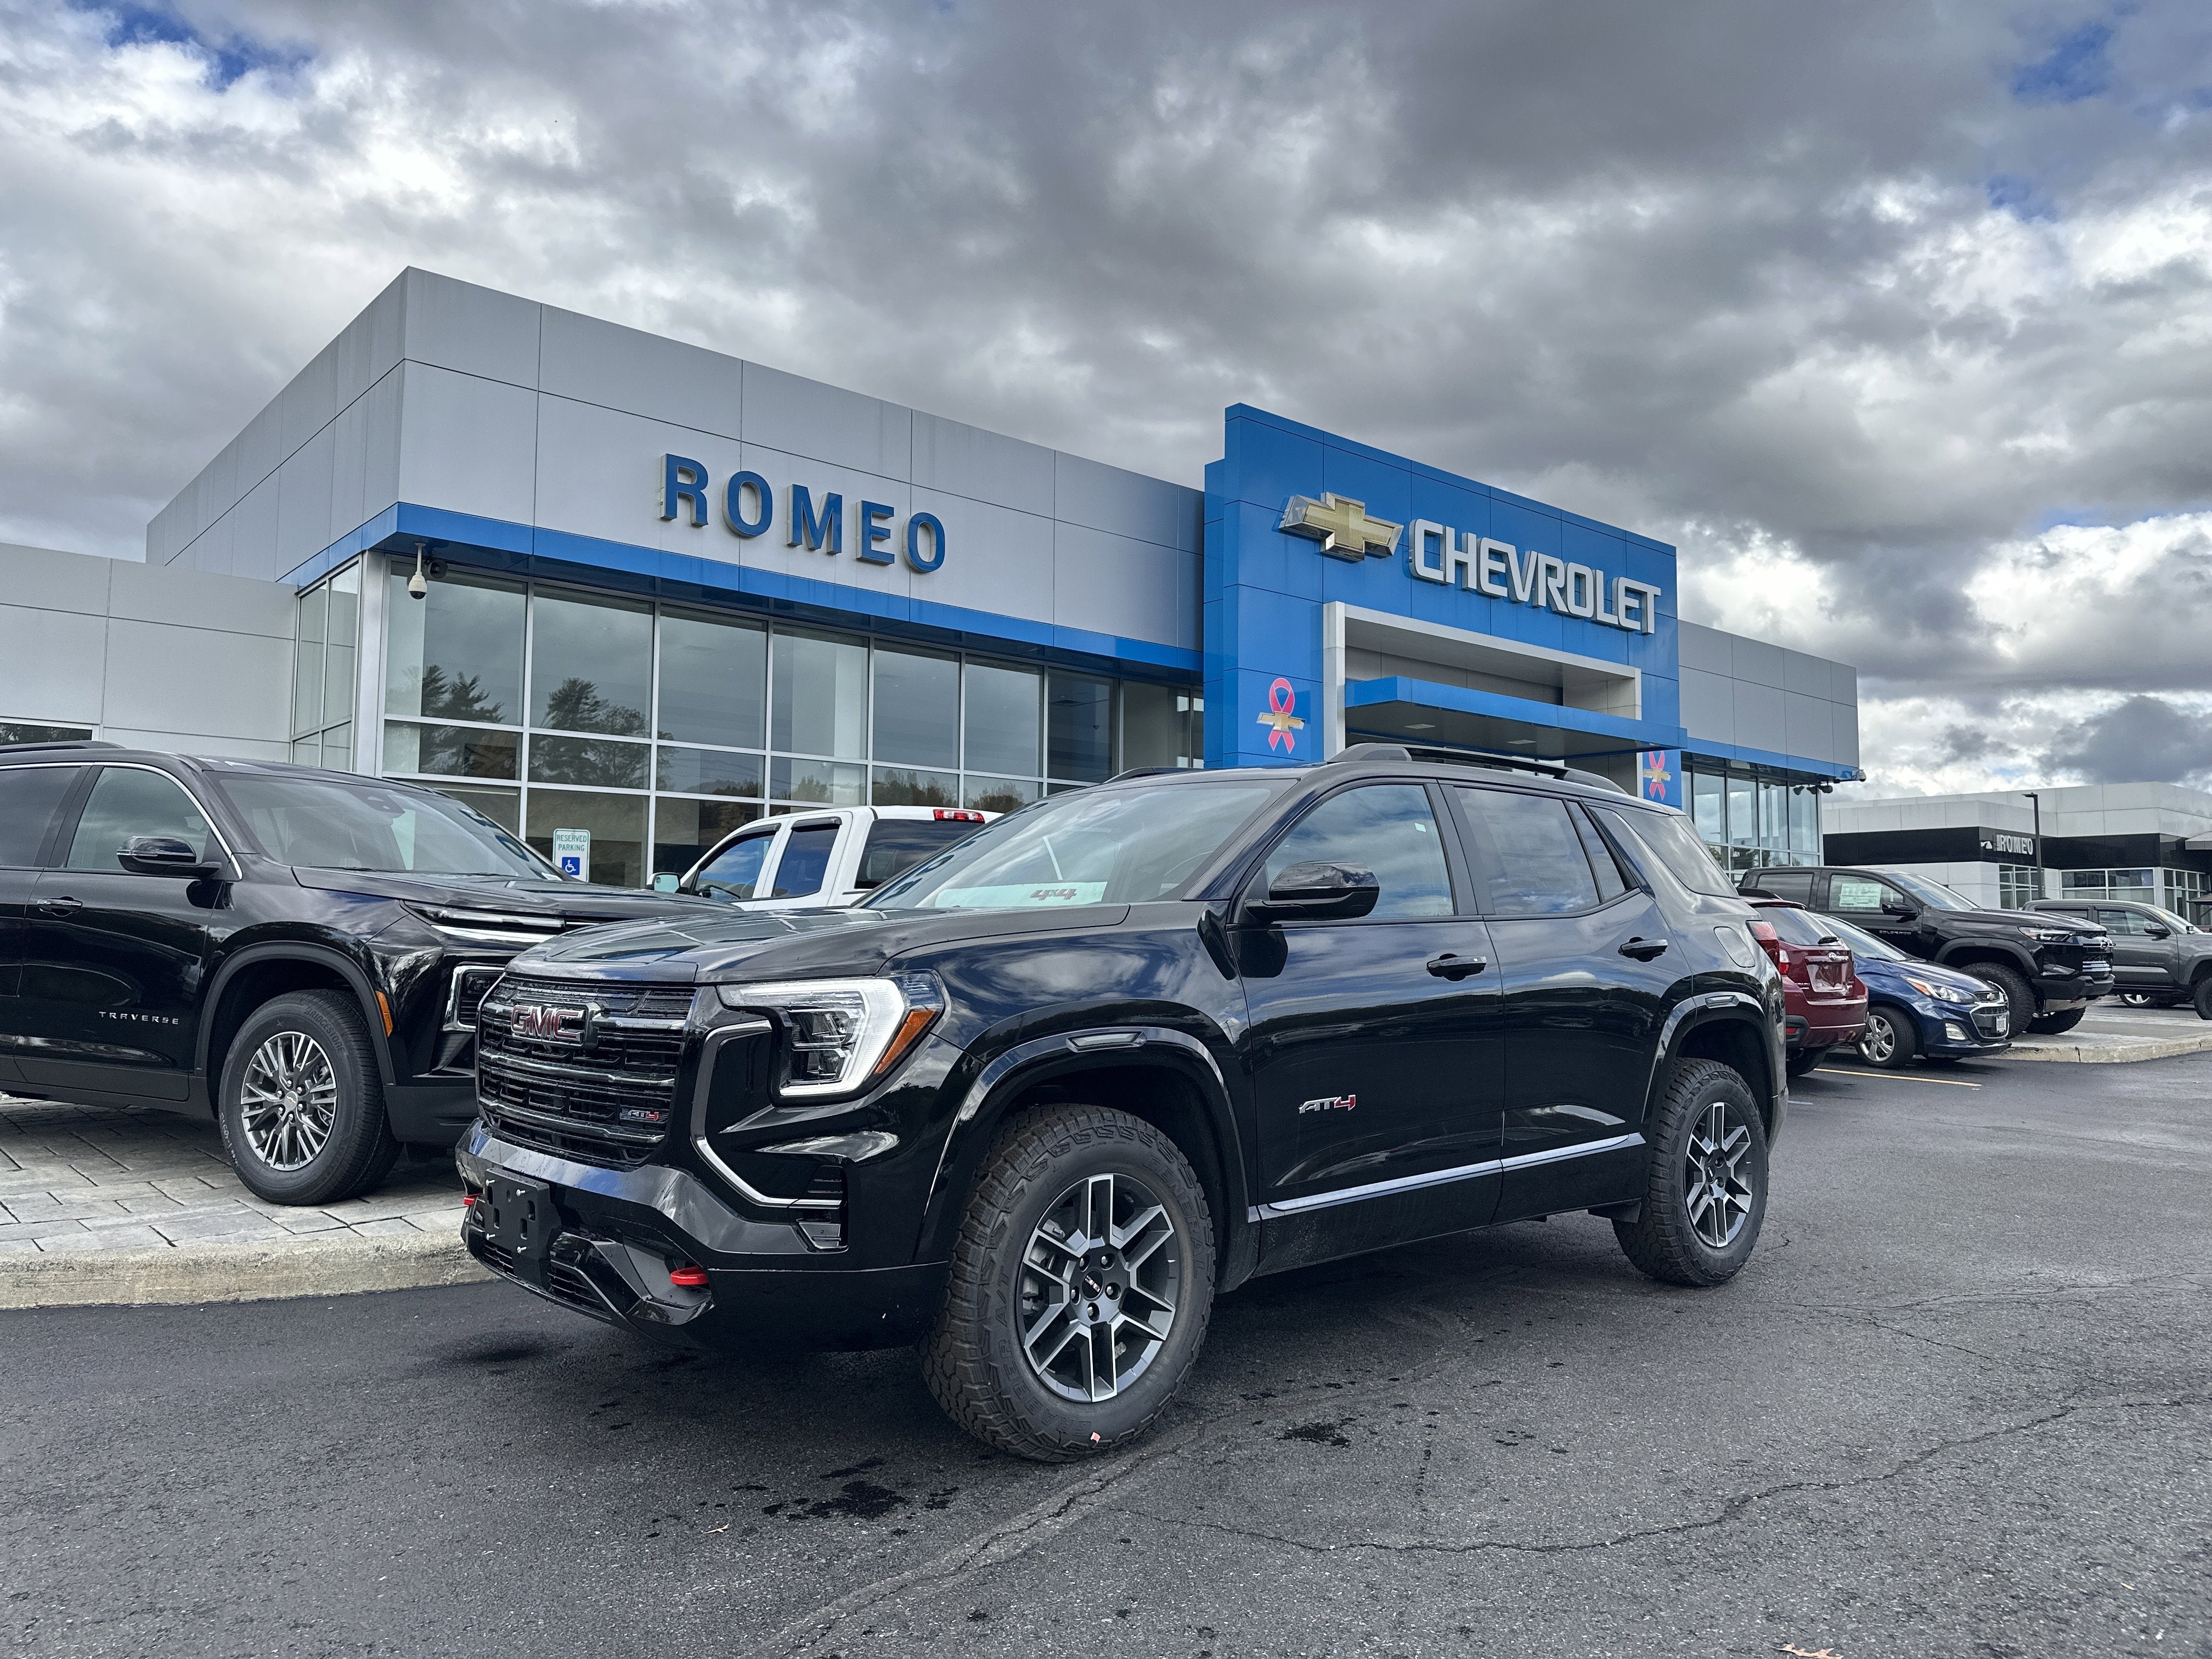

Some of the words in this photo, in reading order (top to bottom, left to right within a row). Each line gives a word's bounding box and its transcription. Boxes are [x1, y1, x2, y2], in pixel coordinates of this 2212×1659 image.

[660, 453, 946, 573] ROMEO
[1408, 517, 1661, 635] CHEVROLET
[1996, 834, 2033, 855] ROMEO
[99, 1011, 179, 1025] TRAVERSE
[511, 1004, 584, 1042] GMC
[628, 1109, 659, 1122] AT4
[1299, 1094, 1356, 1114] AT4
[1142, 1154, 1205, 1279] GENERAL
